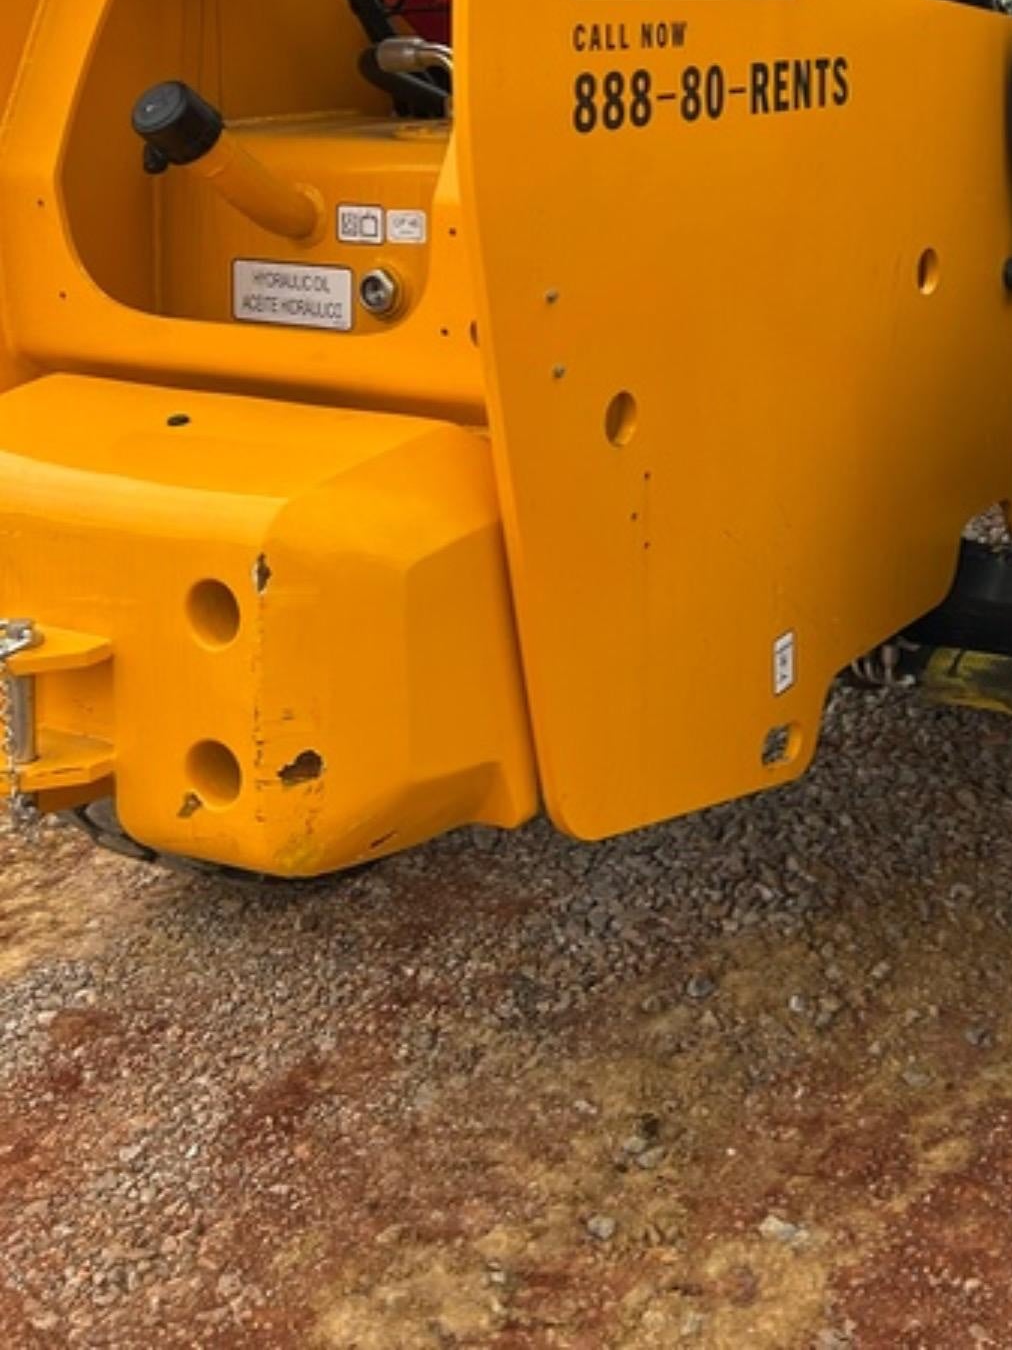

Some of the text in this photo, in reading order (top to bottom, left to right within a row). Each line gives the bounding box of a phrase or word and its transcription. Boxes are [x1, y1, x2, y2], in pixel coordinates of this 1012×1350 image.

[573, 21, 688, 51] CALL NOW
[573, 57, 850, 134] 888-80-RENTS
